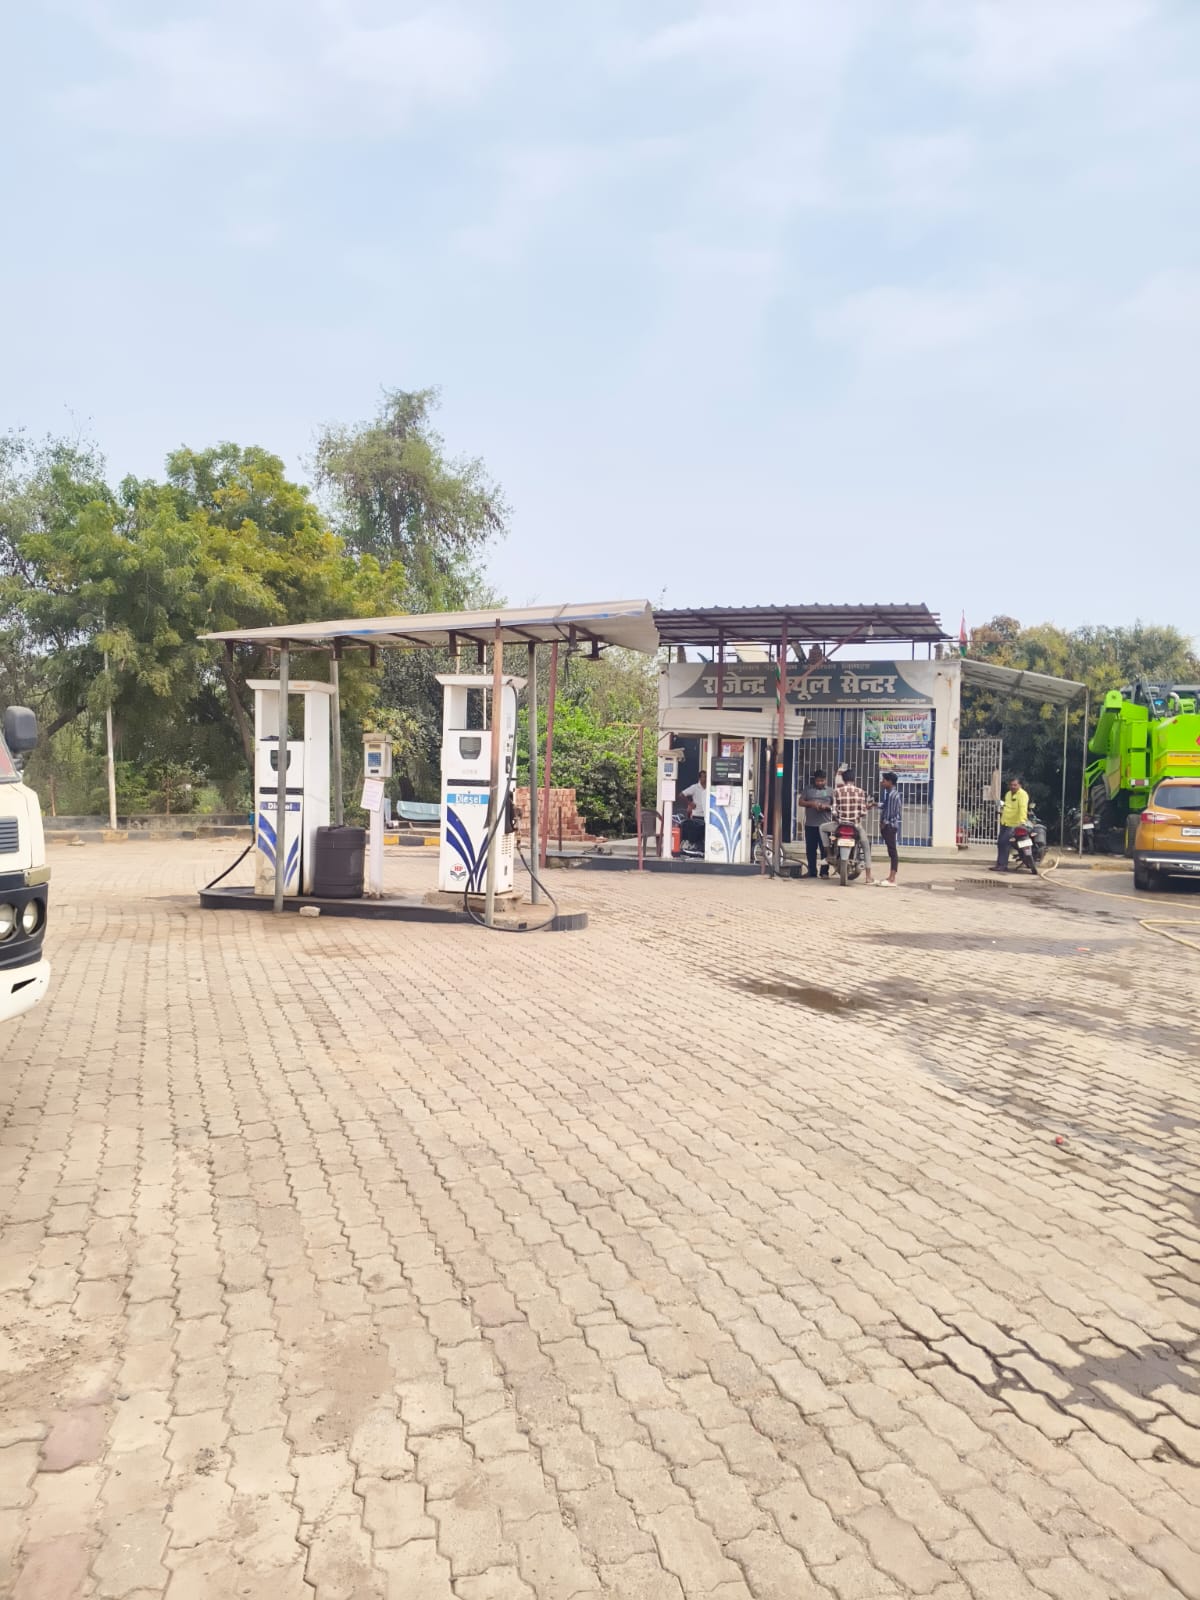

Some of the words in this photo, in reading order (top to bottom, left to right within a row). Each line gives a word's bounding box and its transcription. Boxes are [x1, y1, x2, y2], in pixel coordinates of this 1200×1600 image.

[840, 670, 898, 694] सेन्टर
[456, 793, 480, 804] Diesel
[267, 802, 293, 810] Diel
